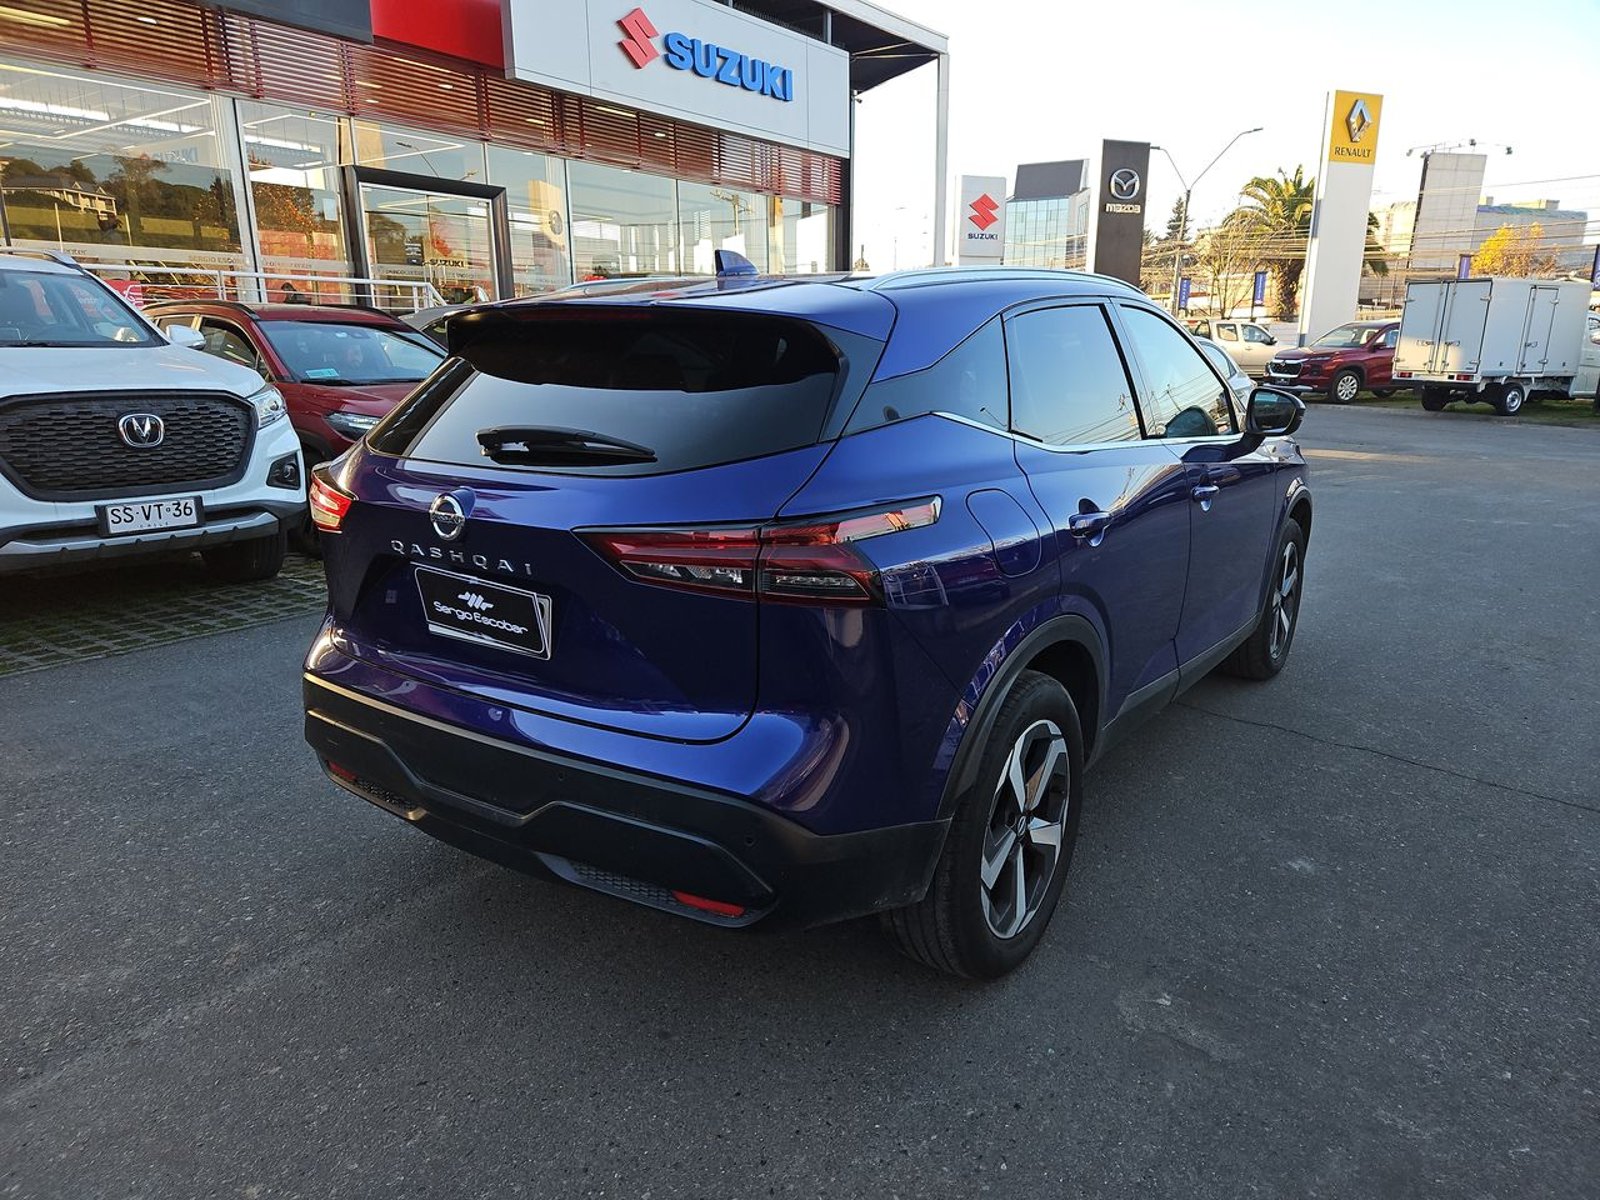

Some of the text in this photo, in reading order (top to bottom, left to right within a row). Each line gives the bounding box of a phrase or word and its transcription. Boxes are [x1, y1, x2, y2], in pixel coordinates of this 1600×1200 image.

[664, 31, 793, 101] SUZUKI
[1334, 146, 1372, 158] RENAULT
[967, 232, 998, 240] SUZUKI
[390, 539, 532, 576] QASHQAI
